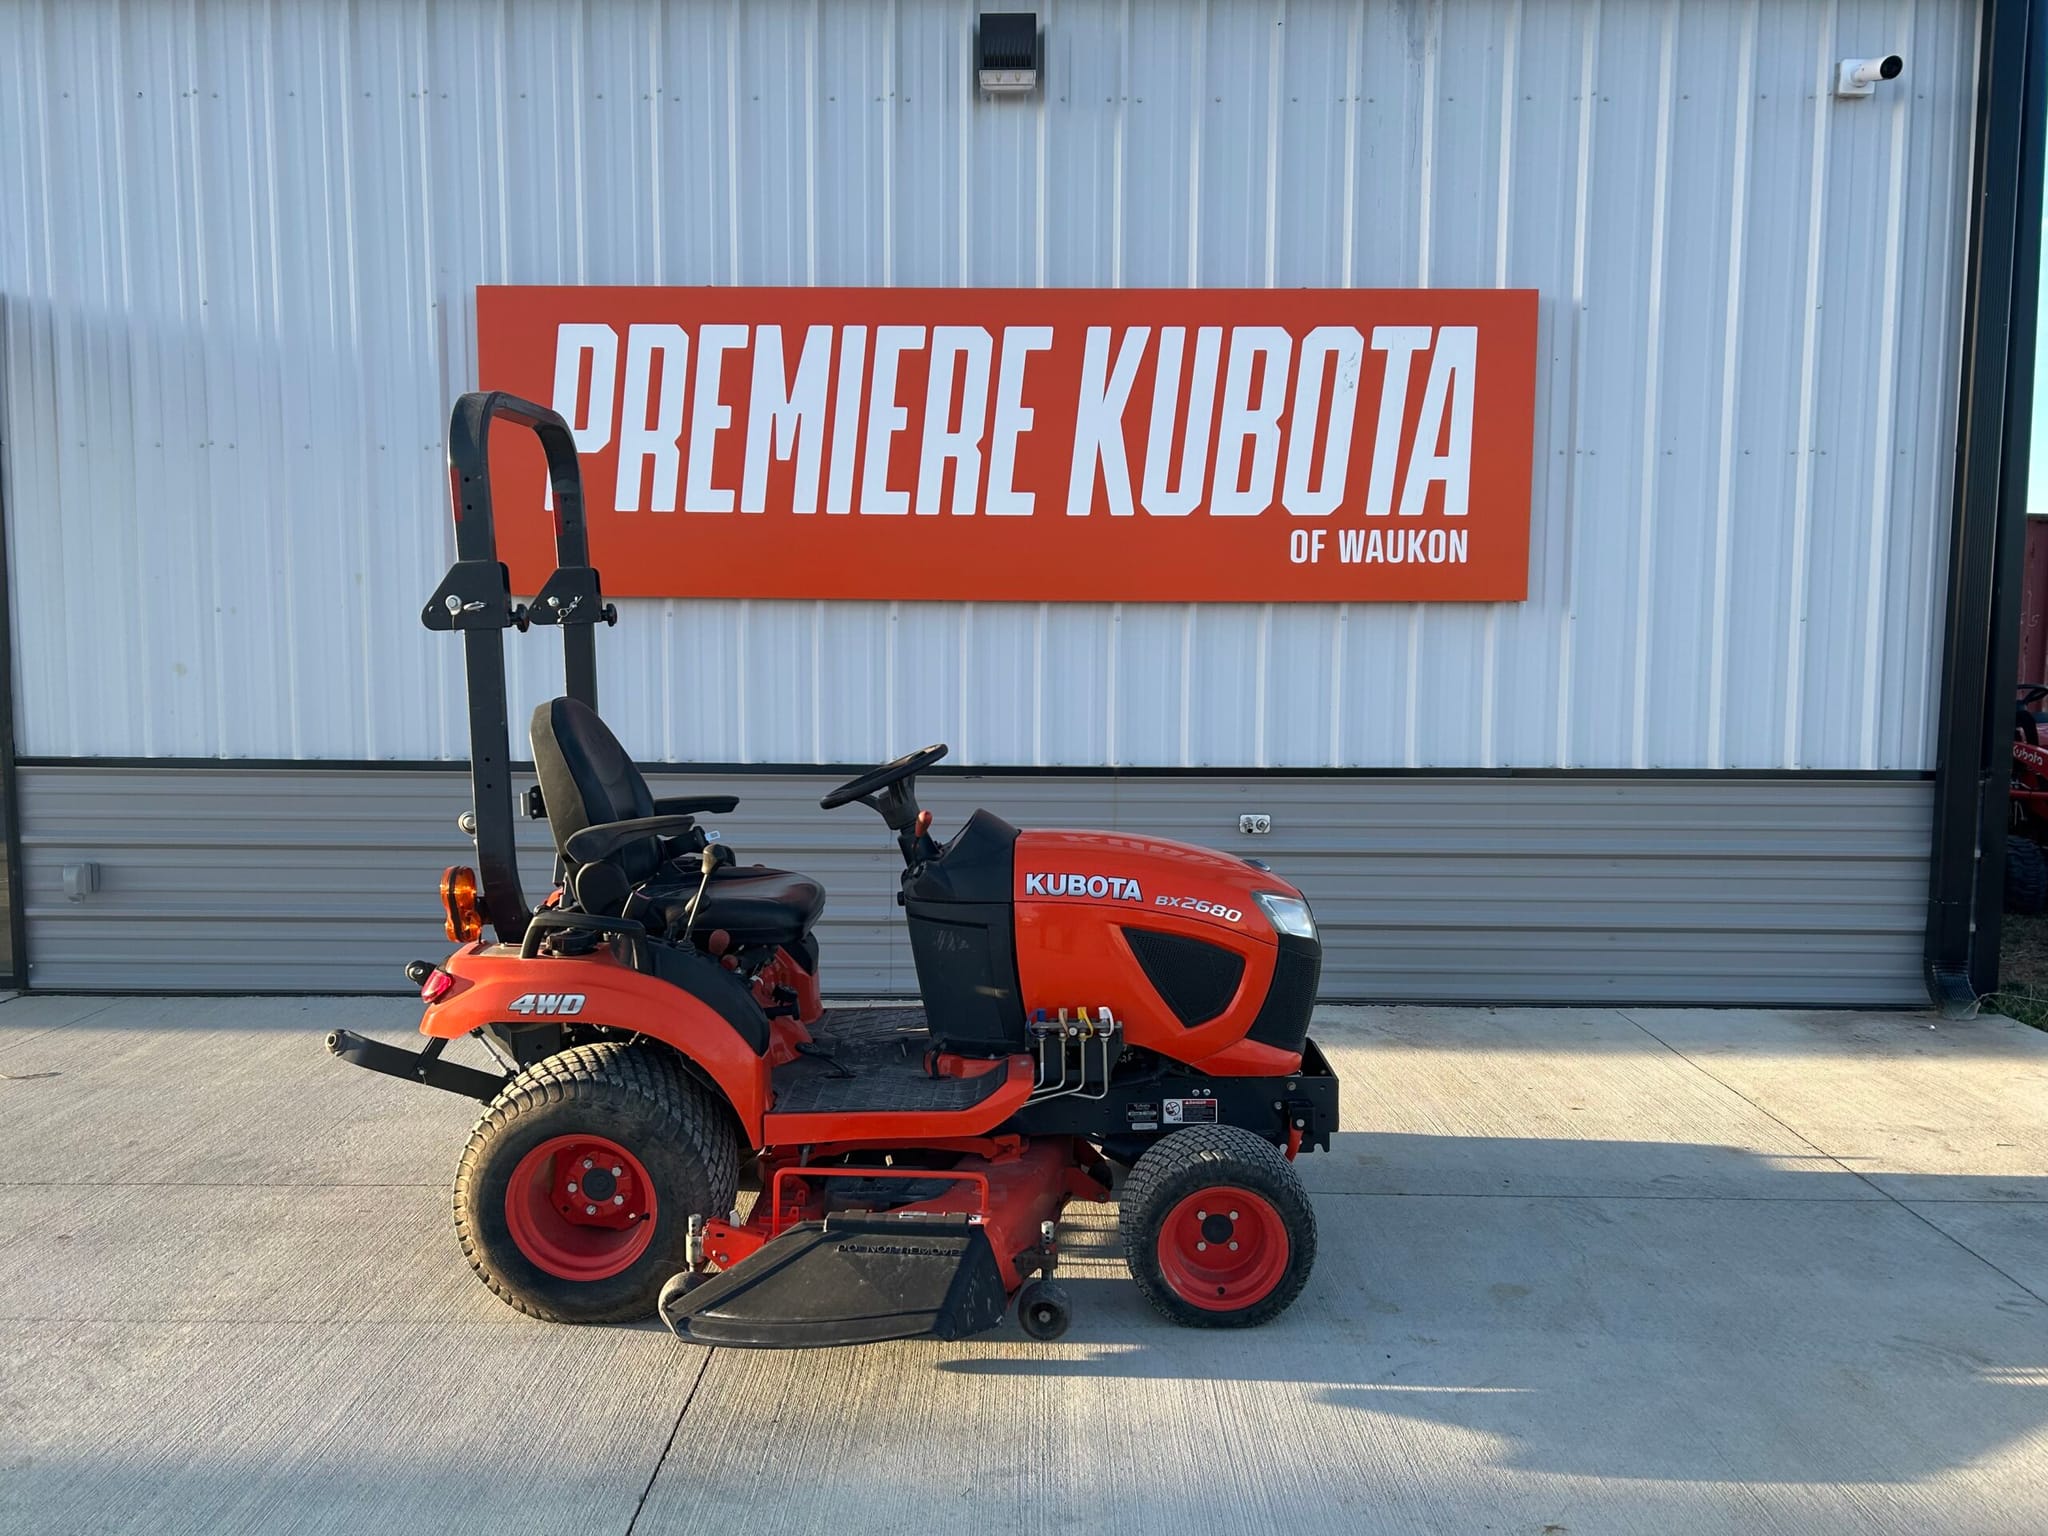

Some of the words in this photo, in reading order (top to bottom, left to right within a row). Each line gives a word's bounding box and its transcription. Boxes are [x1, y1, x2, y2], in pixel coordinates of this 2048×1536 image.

[544, 323, 1054, 516] PREMIERE
[1066, 325, 1479, 517] KUBOTA
[1290, 529, 1328, 564] OF
[1338, 529, 1469, 564] WAUKON
[1025, 872, 1143, 902] KUBOTA
[1154, 895, 1242, 922] BX2680
[508, 993, 587, 1016] 4WD
